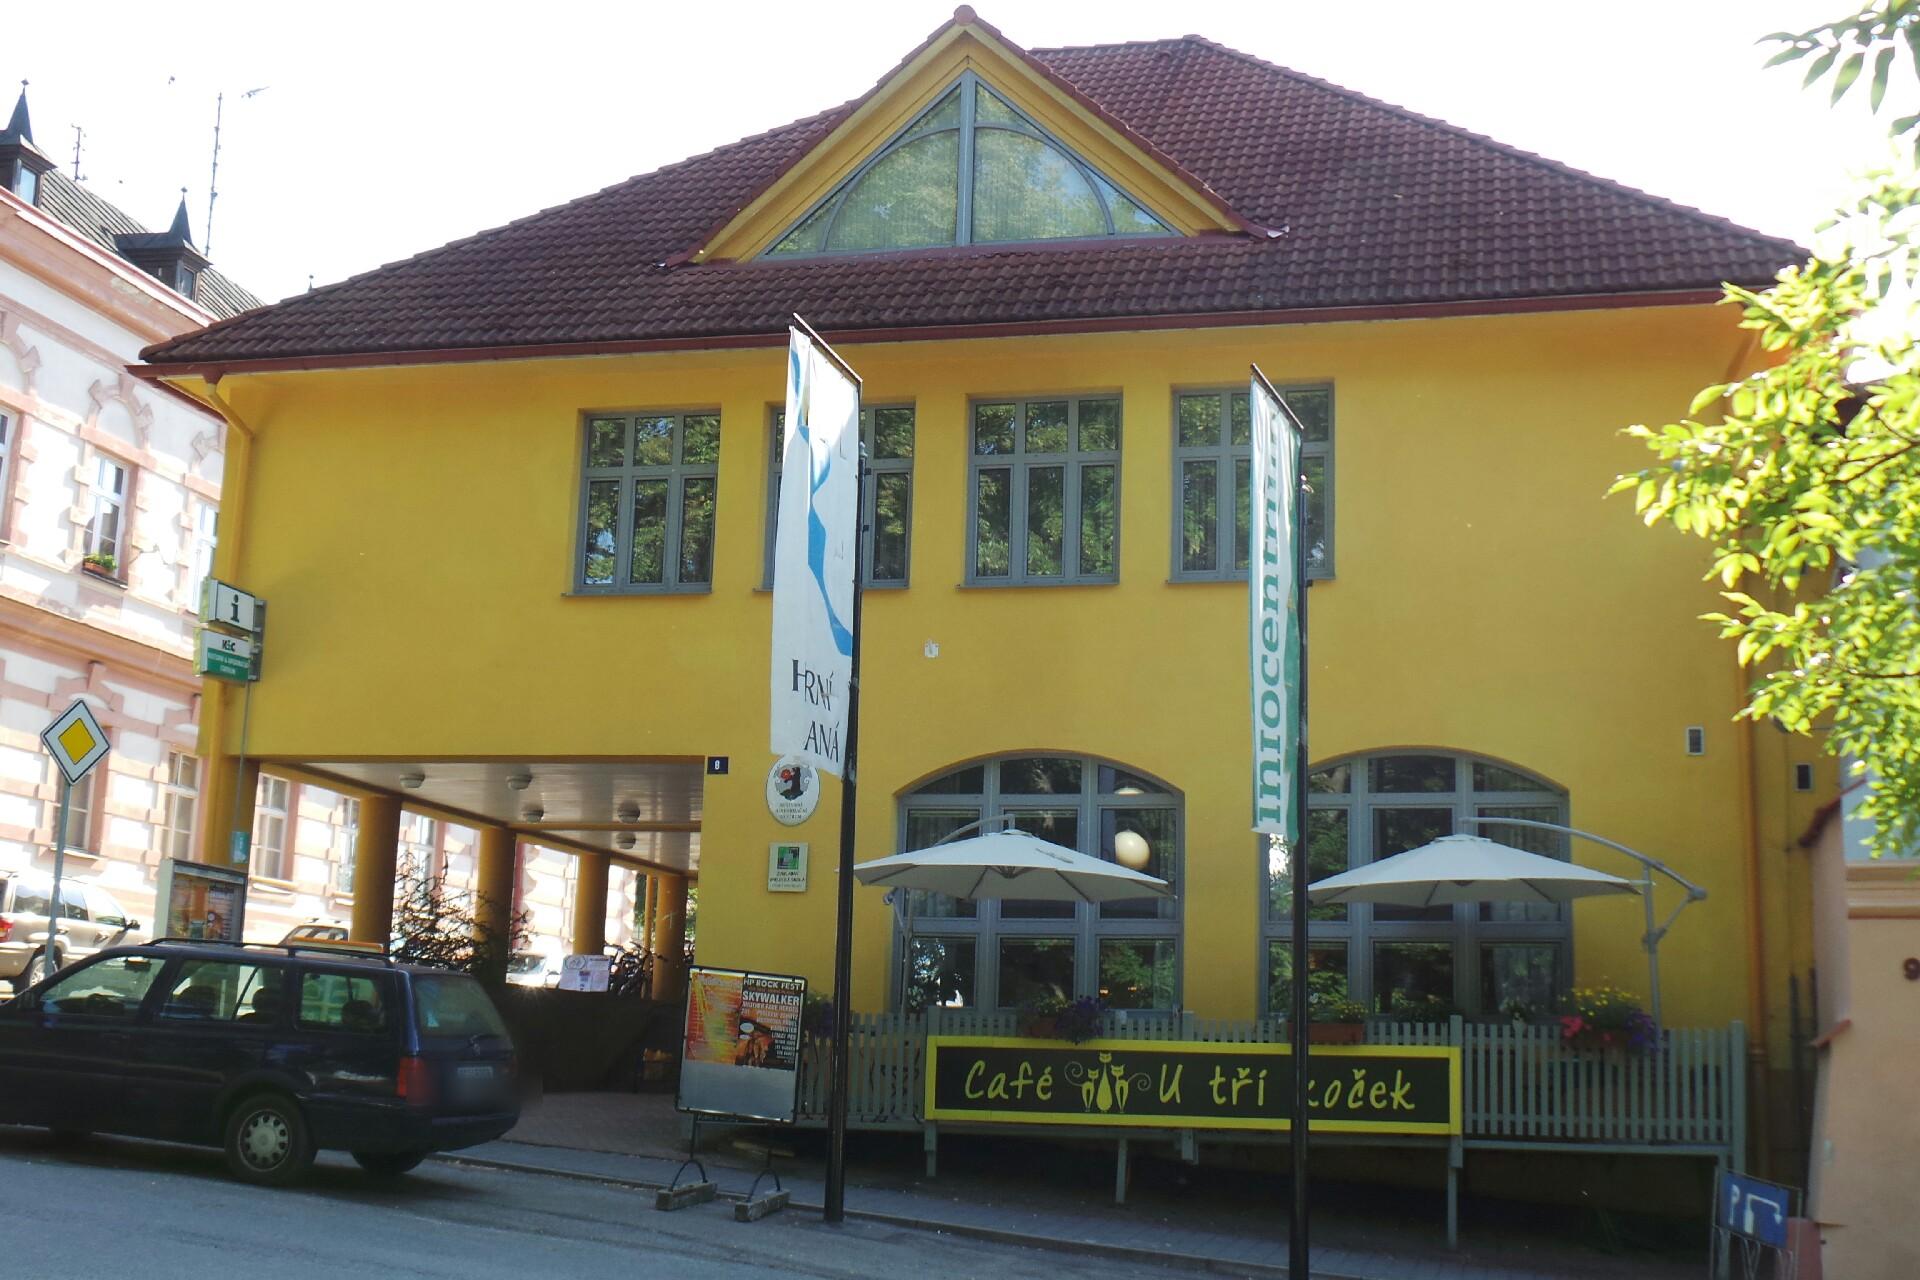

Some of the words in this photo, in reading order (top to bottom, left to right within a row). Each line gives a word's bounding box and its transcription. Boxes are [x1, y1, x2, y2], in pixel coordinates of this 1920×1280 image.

[742, 990, 800, 1006] SKYWALKER
[743, 977, 755, 986] HP
[755, 979, 779, 989] ROCK
[781, 981, 801, 991] FEST
[964, 1059, 1053, 1100] Café
[1159, 1063, 1183, 1104] U
[1208, 1064, 1268, 1106] tří
[1728, 1183, 1741, 1226] P
